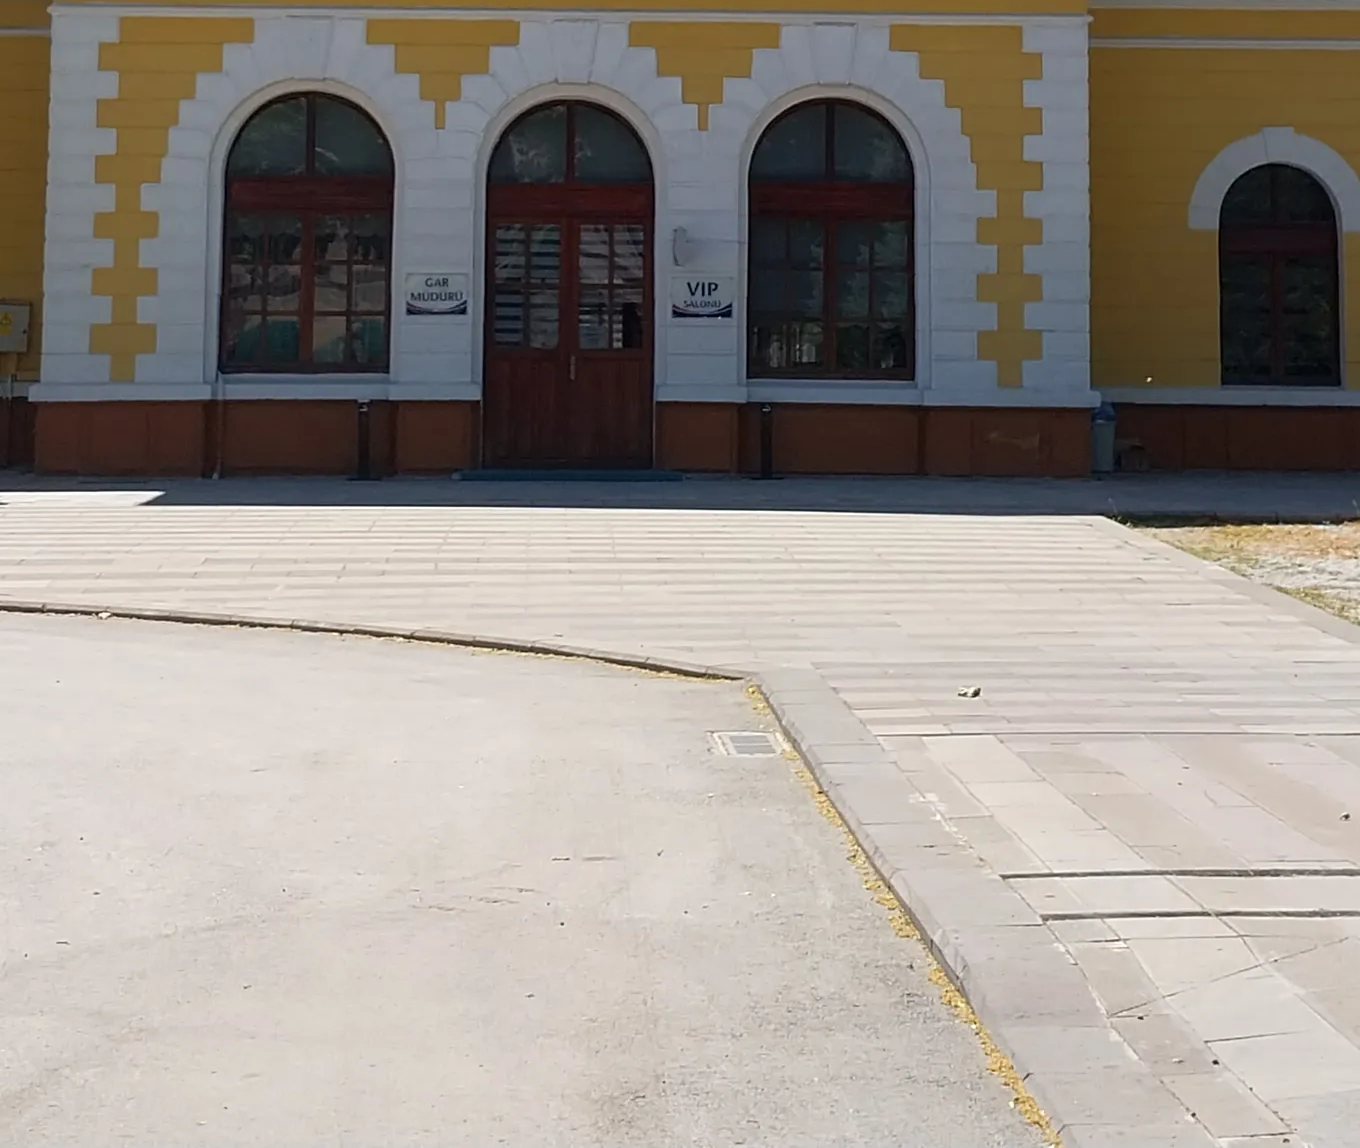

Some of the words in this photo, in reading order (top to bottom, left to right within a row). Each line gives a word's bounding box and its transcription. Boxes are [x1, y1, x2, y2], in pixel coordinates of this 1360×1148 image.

[424, 277, 449, 288] GAR
[686, 281, 719, 297] VIP
[683, 299, 722, 309] SALONU
